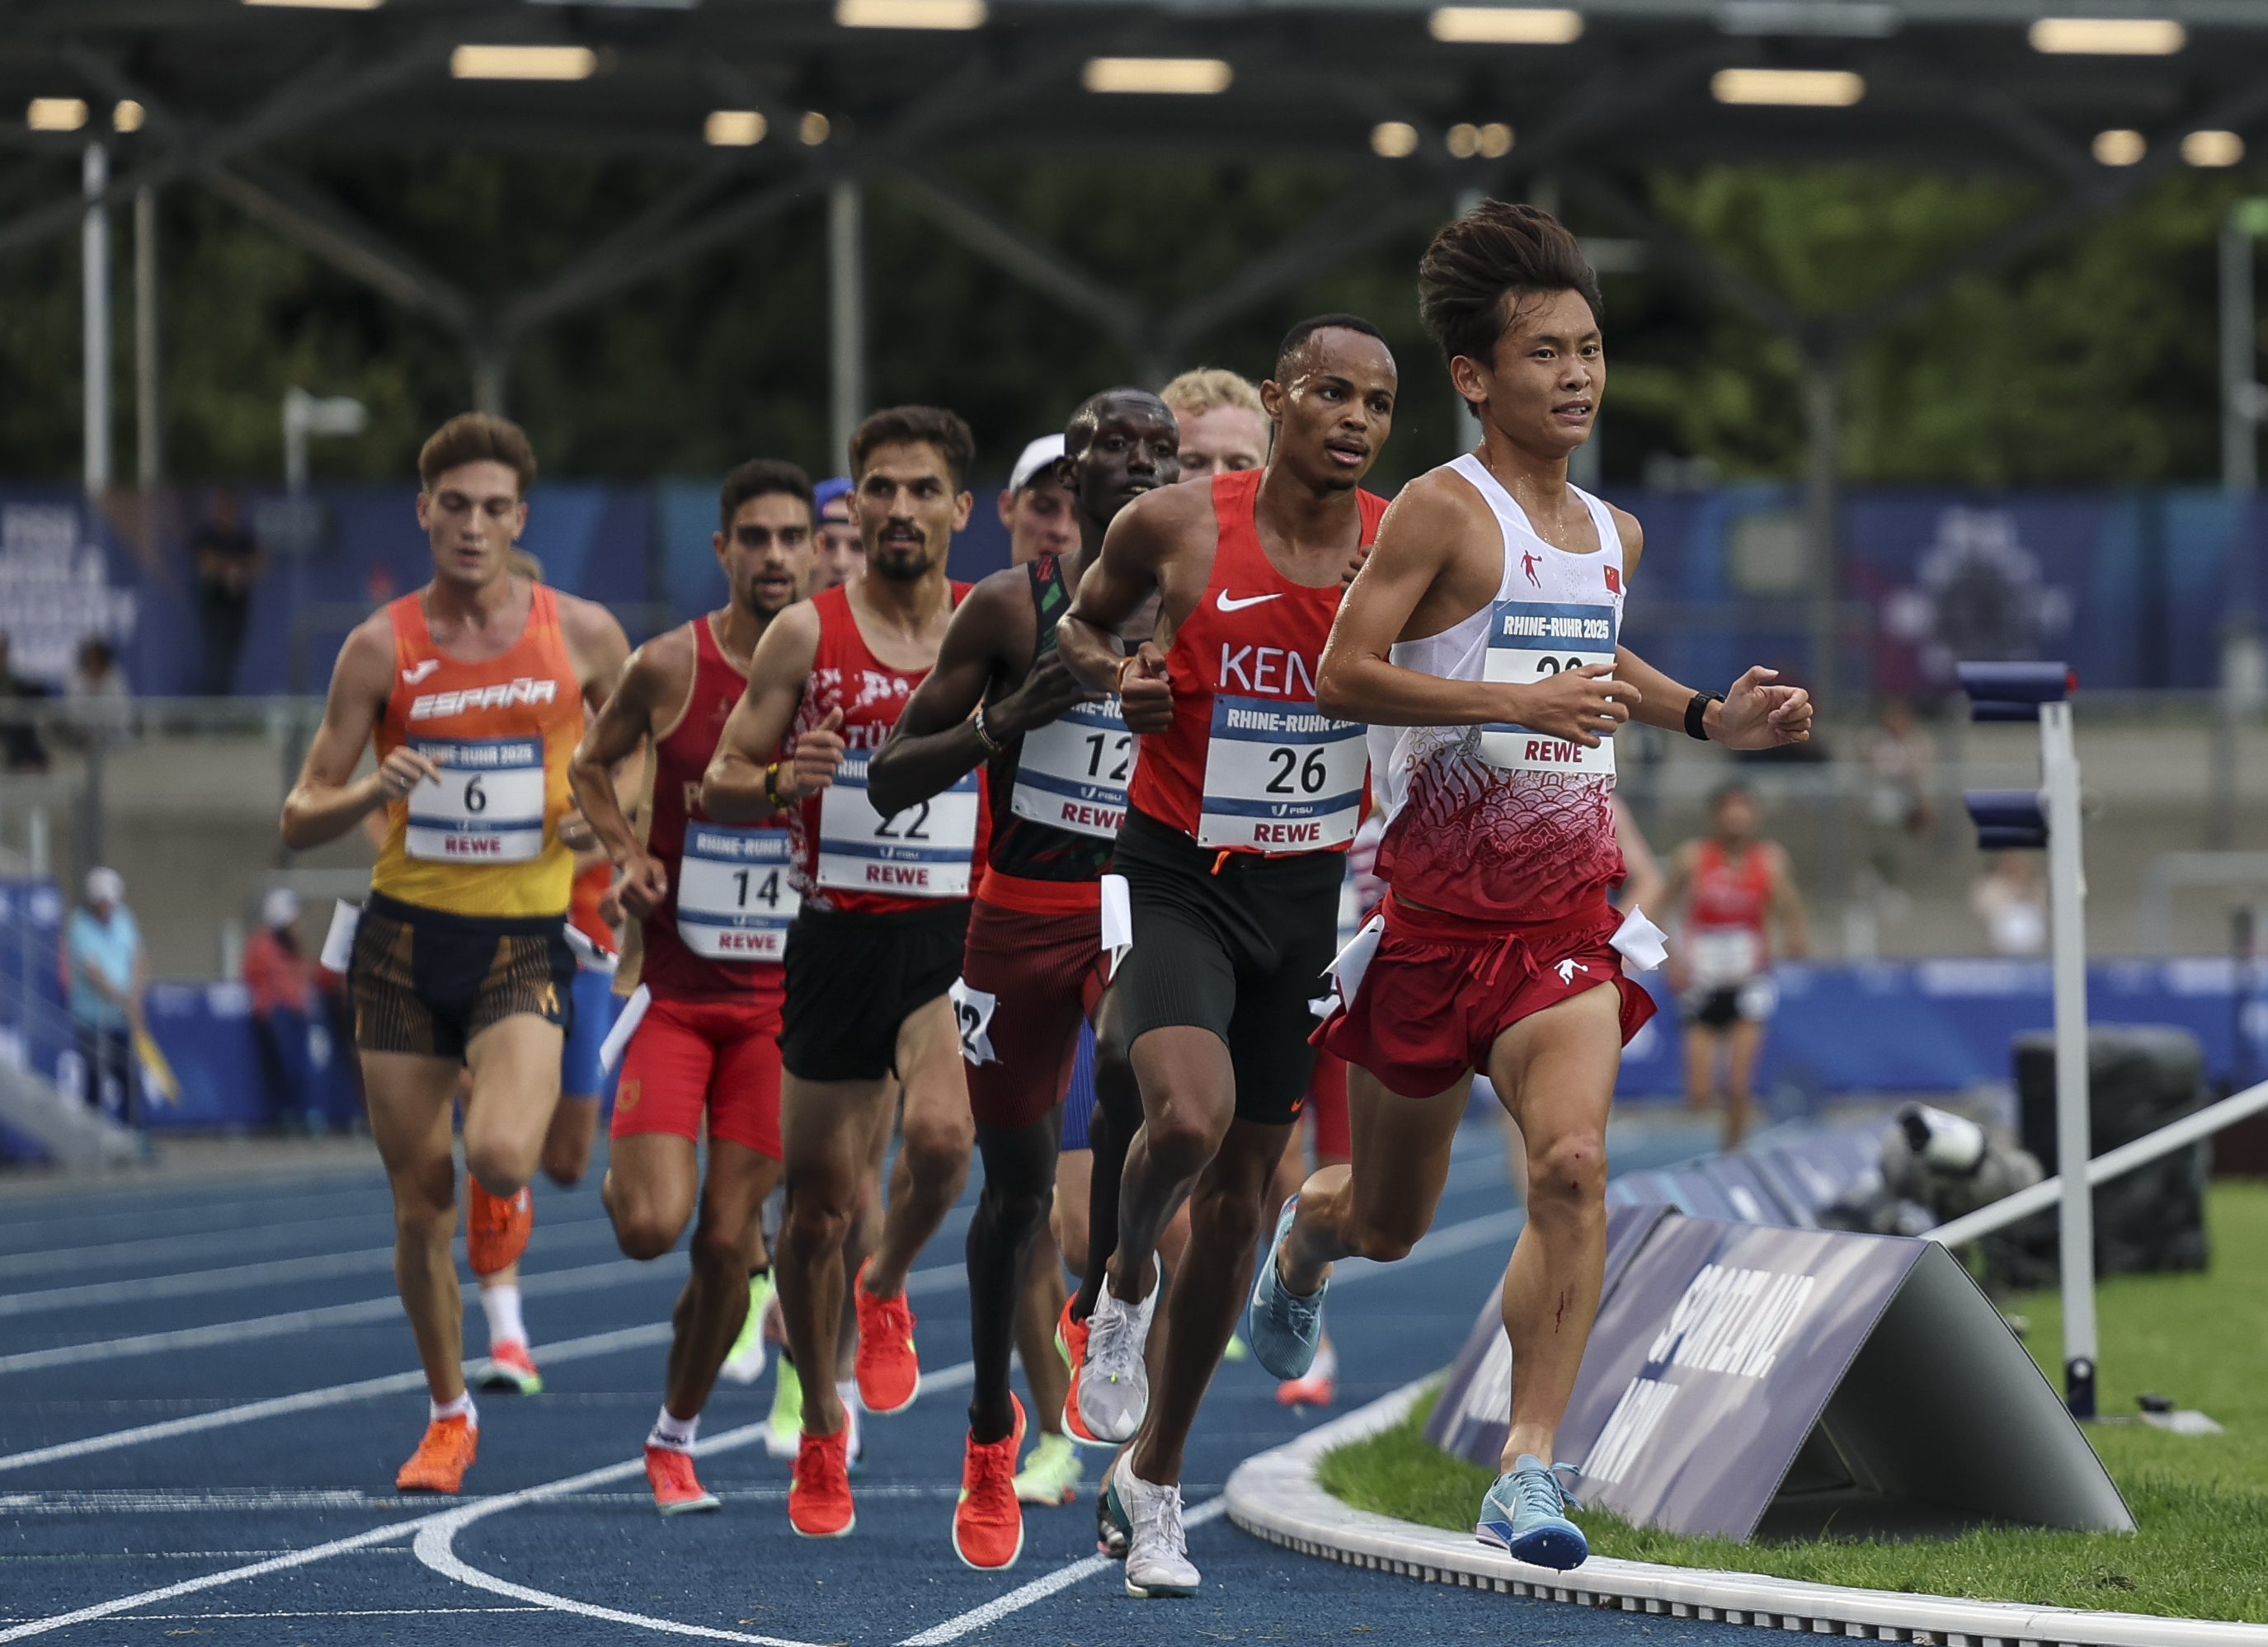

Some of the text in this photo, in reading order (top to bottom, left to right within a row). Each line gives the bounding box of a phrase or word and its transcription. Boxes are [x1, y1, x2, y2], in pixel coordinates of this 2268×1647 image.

[1503, 615, 1609, 639] RHINE-RUHR 2025
[1220, 642, 1321, 696] KEN
[409, 677, 558, 721] ESPAÑA
[1227, 708, 1330, 732] RHINE-RUHR
[1085, 732, 1131, 781] 12
[1525, 740, 1583, 763] REWE
[1265, 746, 1326, 793] 26
[463, 773, 487, 814] 6
[1290, 806, 1313, 814] FISU
[445, 835, 501, 854] REWE
[1254, 822, 1321, 843] REWE
[866, 863, 929, 885] REWE
[733, 868, 779, 908] 14
[718, 933, 777, 949] REWE
